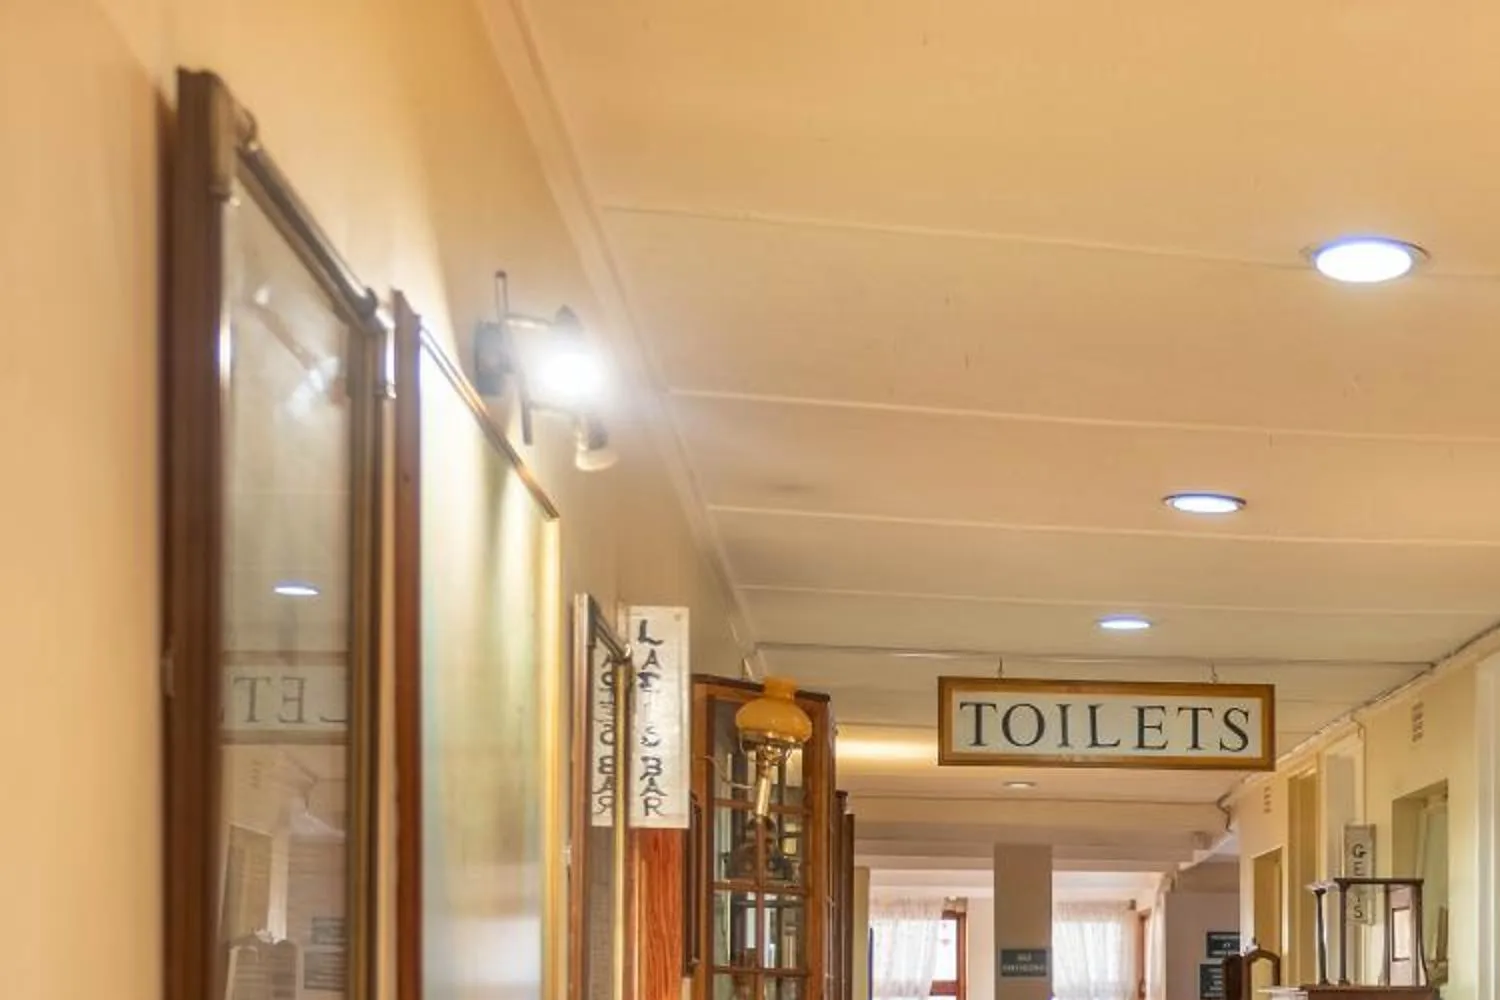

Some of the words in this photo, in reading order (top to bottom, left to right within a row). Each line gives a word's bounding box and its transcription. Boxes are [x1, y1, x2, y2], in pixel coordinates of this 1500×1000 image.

[637, 619, 664, 747] LADS
[959, 702, 1250, 752] TOILETS
[640, 756, 669, 816] BAR
[1352, 843, 1368, 919] GES
